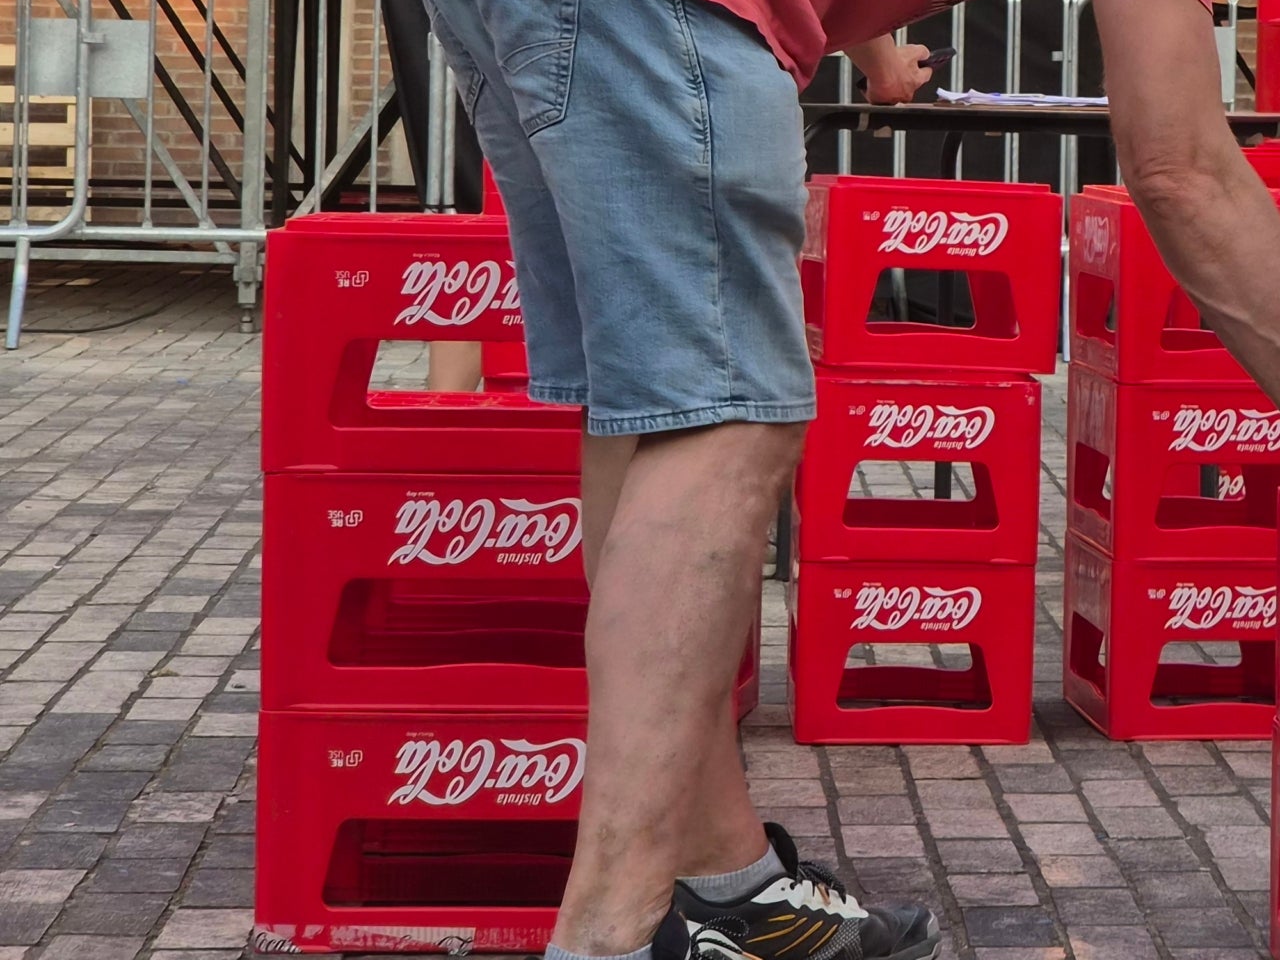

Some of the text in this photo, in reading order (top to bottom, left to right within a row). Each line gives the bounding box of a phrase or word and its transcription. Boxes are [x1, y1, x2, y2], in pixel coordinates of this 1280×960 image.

[877, 210, 1009, 256] Coca-Cola
[393, 259, 521, 326] a-Cola
[863, 404, 996, 449] Coca-Cola
[387, 497, 583, 566] Coca-Cola
[497, 552, 543, 566] Disfruta
[850, 586, 982, 630] Coca-Cola
[387, 738, 586, 806] Coca-Cola
[497, 793, 543, 806] Disfruta
